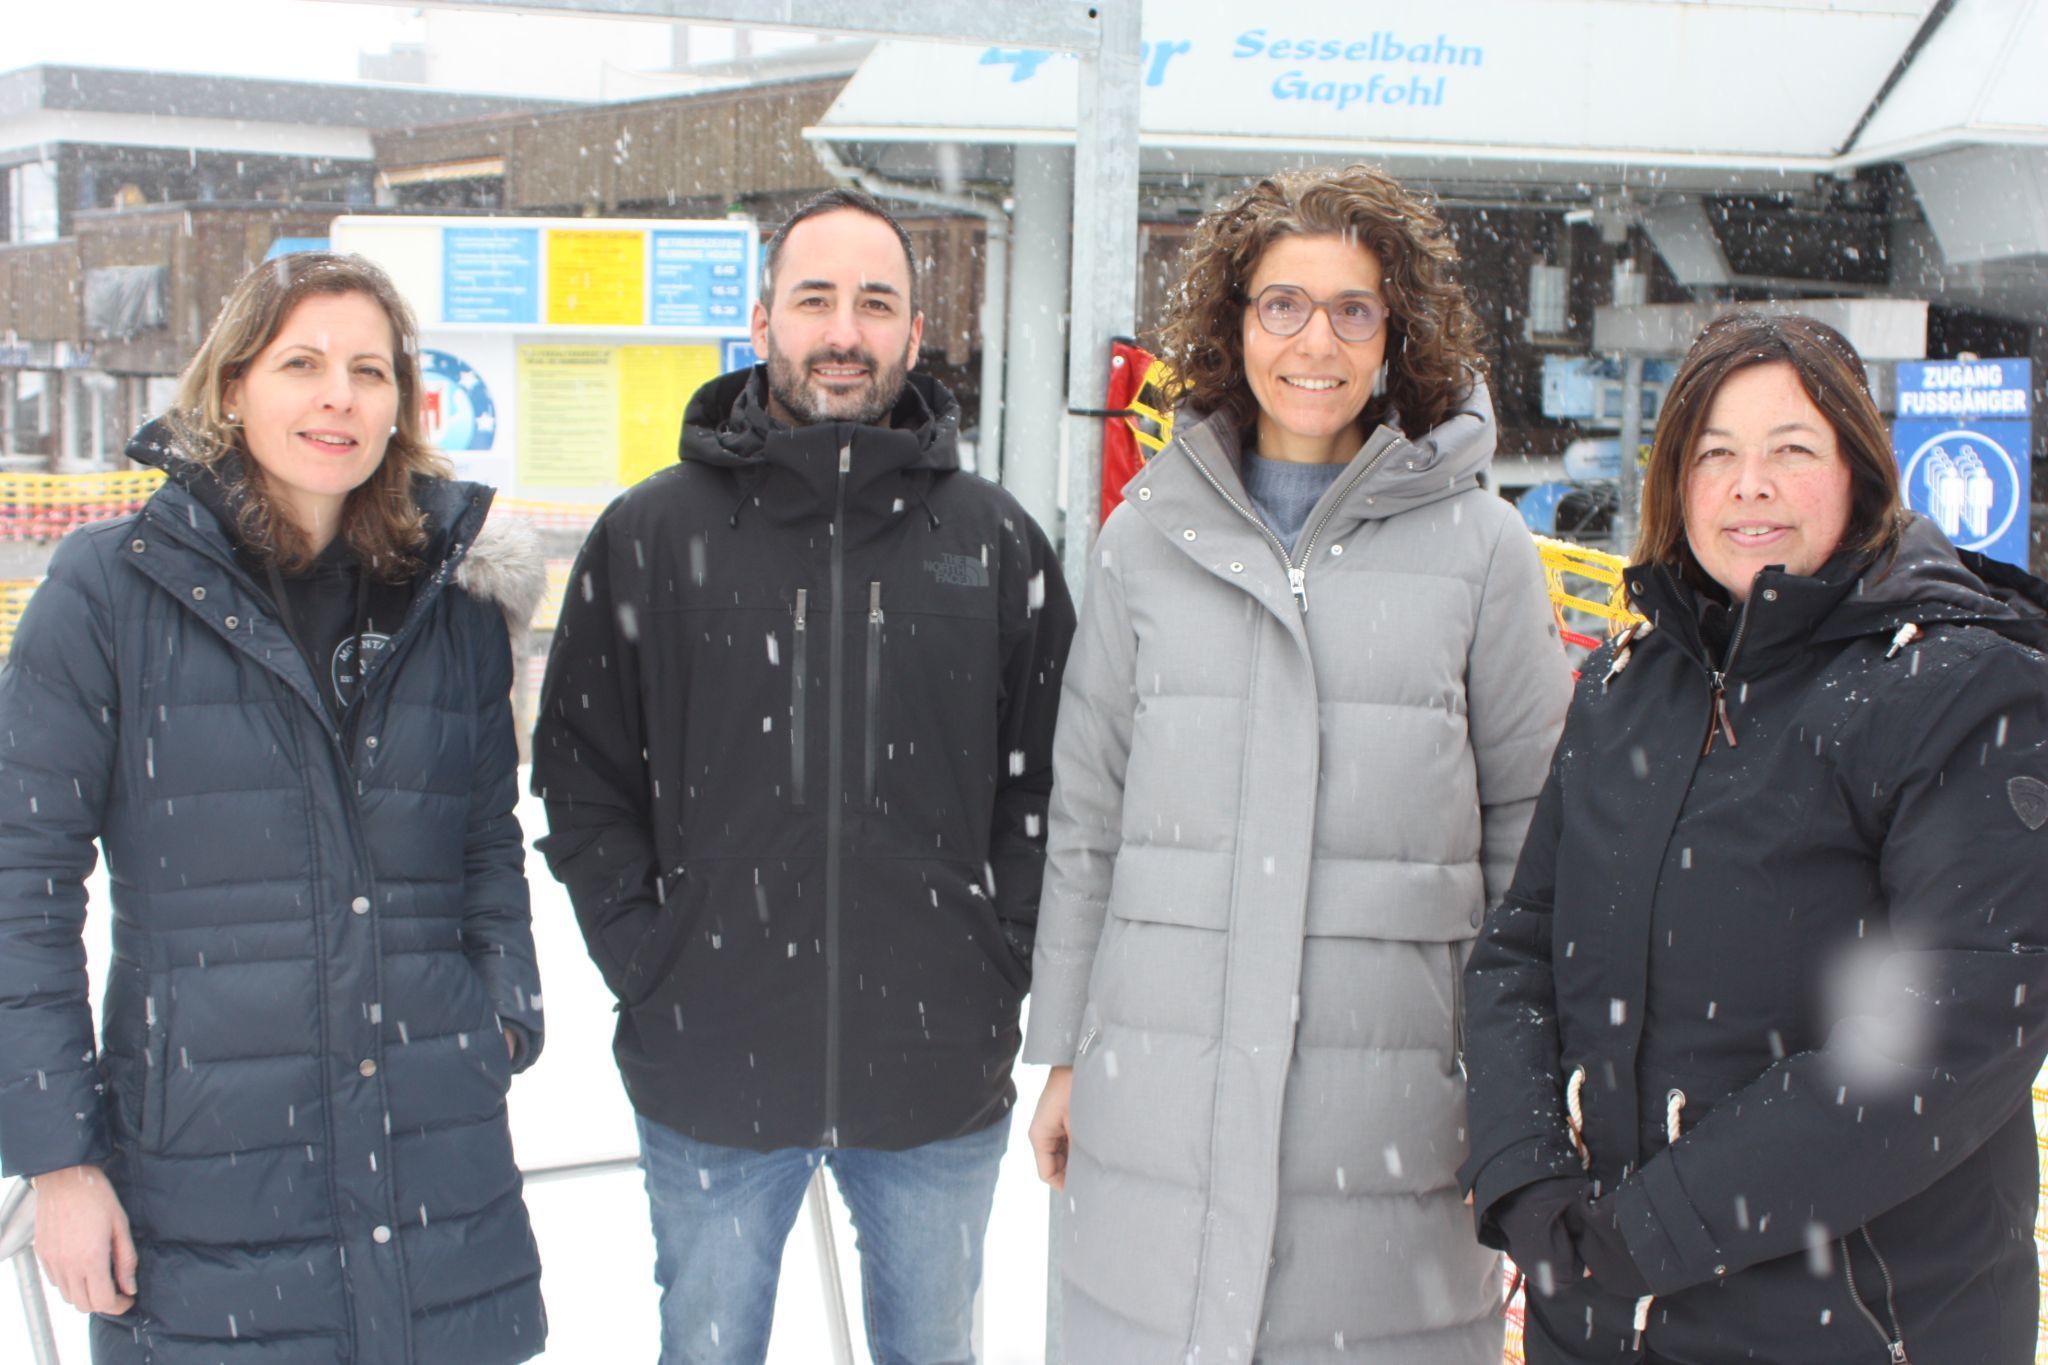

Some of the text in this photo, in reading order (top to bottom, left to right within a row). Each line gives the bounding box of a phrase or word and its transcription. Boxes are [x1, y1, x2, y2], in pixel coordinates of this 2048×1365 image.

[1232, 28, 1484, 67] Sesselbahn
[1270, 70, 1447, 111] Gapfohl
[1922, 365, 2002, 388] ZUGANG
[1901, 388, 2027, 414] FUSSGÄNGER
